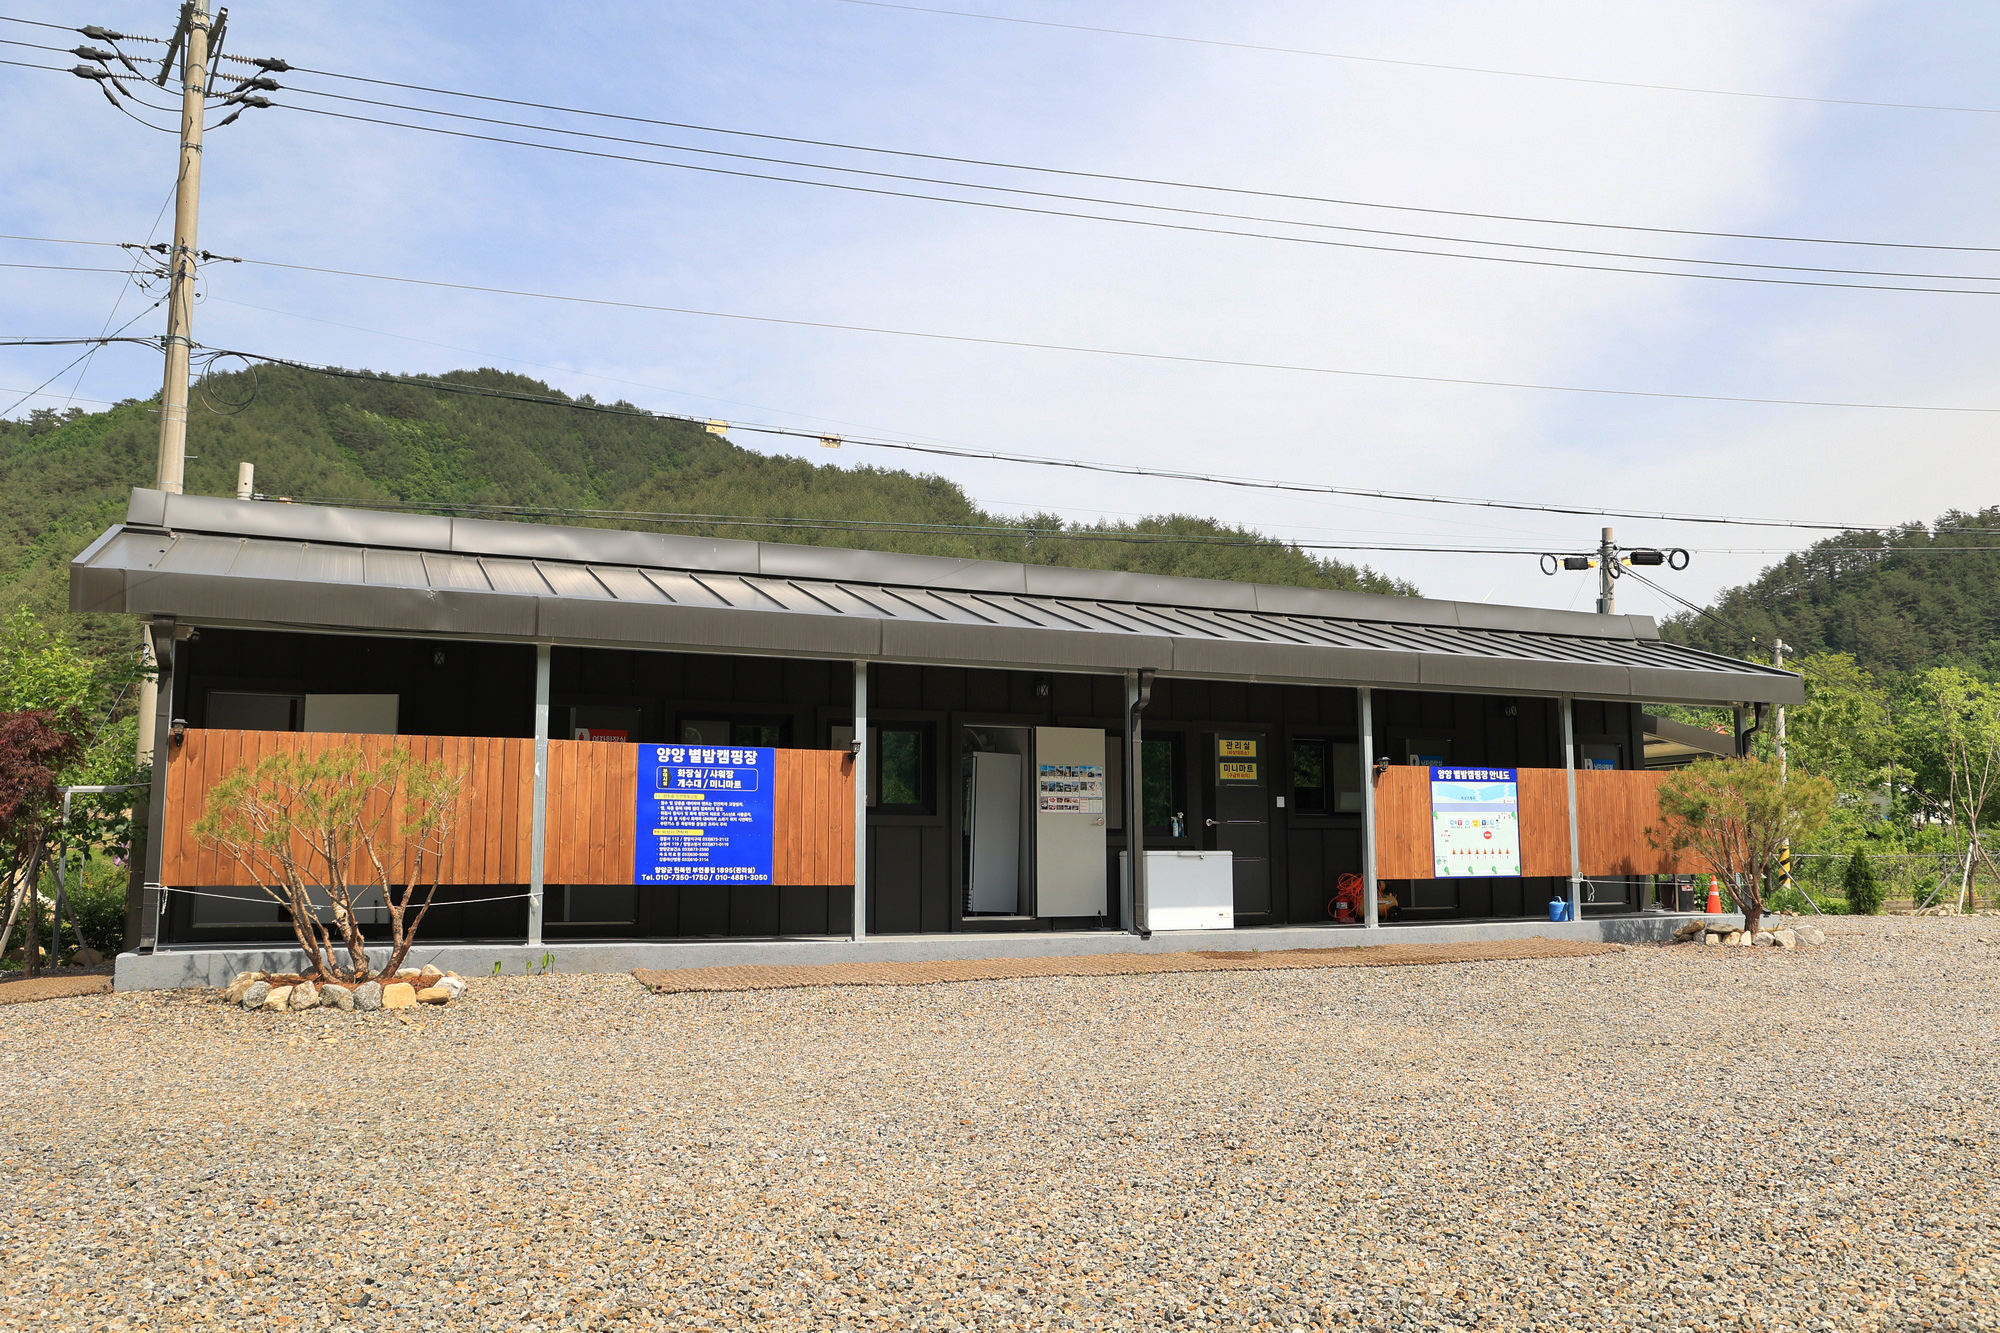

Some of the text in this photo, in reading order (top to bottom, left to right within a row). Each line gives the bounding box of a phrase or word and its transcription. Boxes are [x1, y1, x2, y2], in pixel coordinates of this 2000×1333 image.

[1226, 741, 1250, 750] 관리실
[656, 748, 758, 765] 양양 별밤캠핑장
[1224, 764, 1254, 772] 미니마트
[677, 769, 734, 778] 화장실 / 샤워장
[1438, 769, 1510, 780] 양양 별밤캠핑장 안내도
[677, 779, 742, 788] 개수대 / 미니마트
